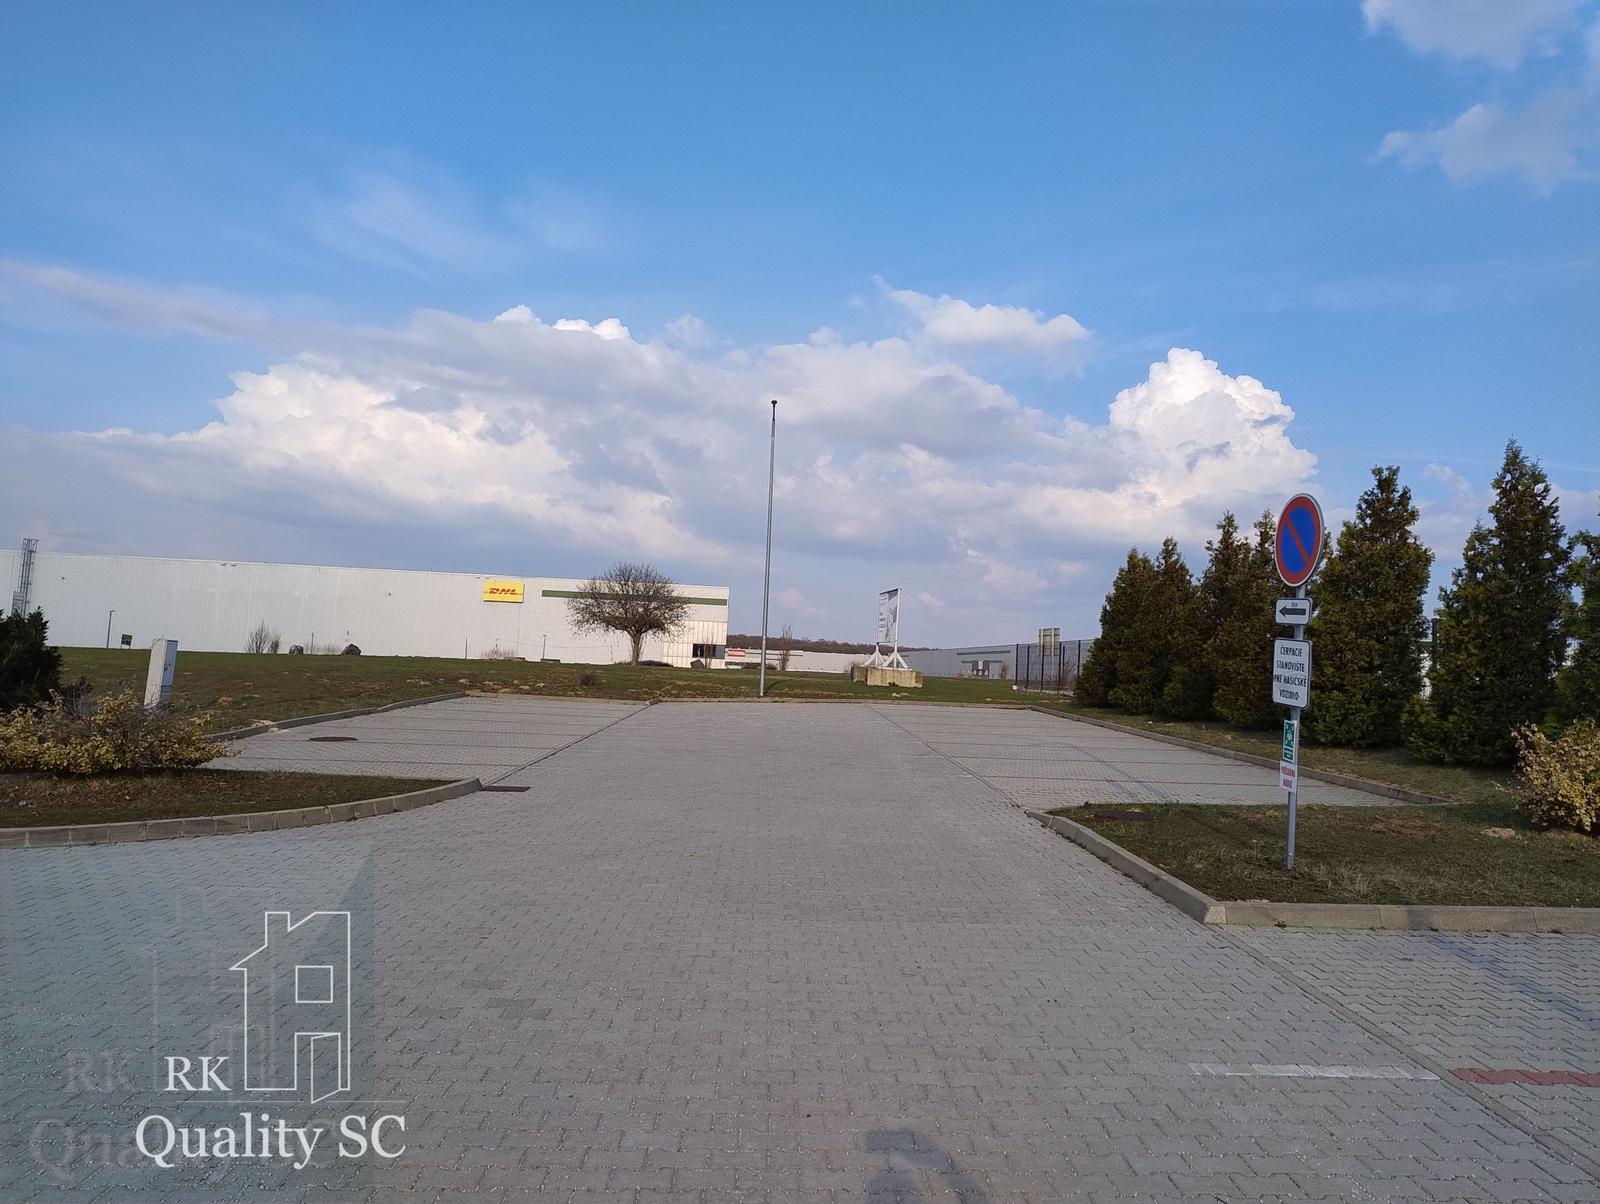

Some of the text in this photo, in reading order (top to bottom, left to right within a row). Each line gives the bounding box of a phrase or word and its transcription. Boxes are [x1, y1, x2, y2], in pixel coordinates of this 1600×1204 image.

[489, 587, 518, 596] DHL
[1279, 644, 1303, 657] ČERPACIE
[1276, 659, 1305, 673] STANOVIŠTE
